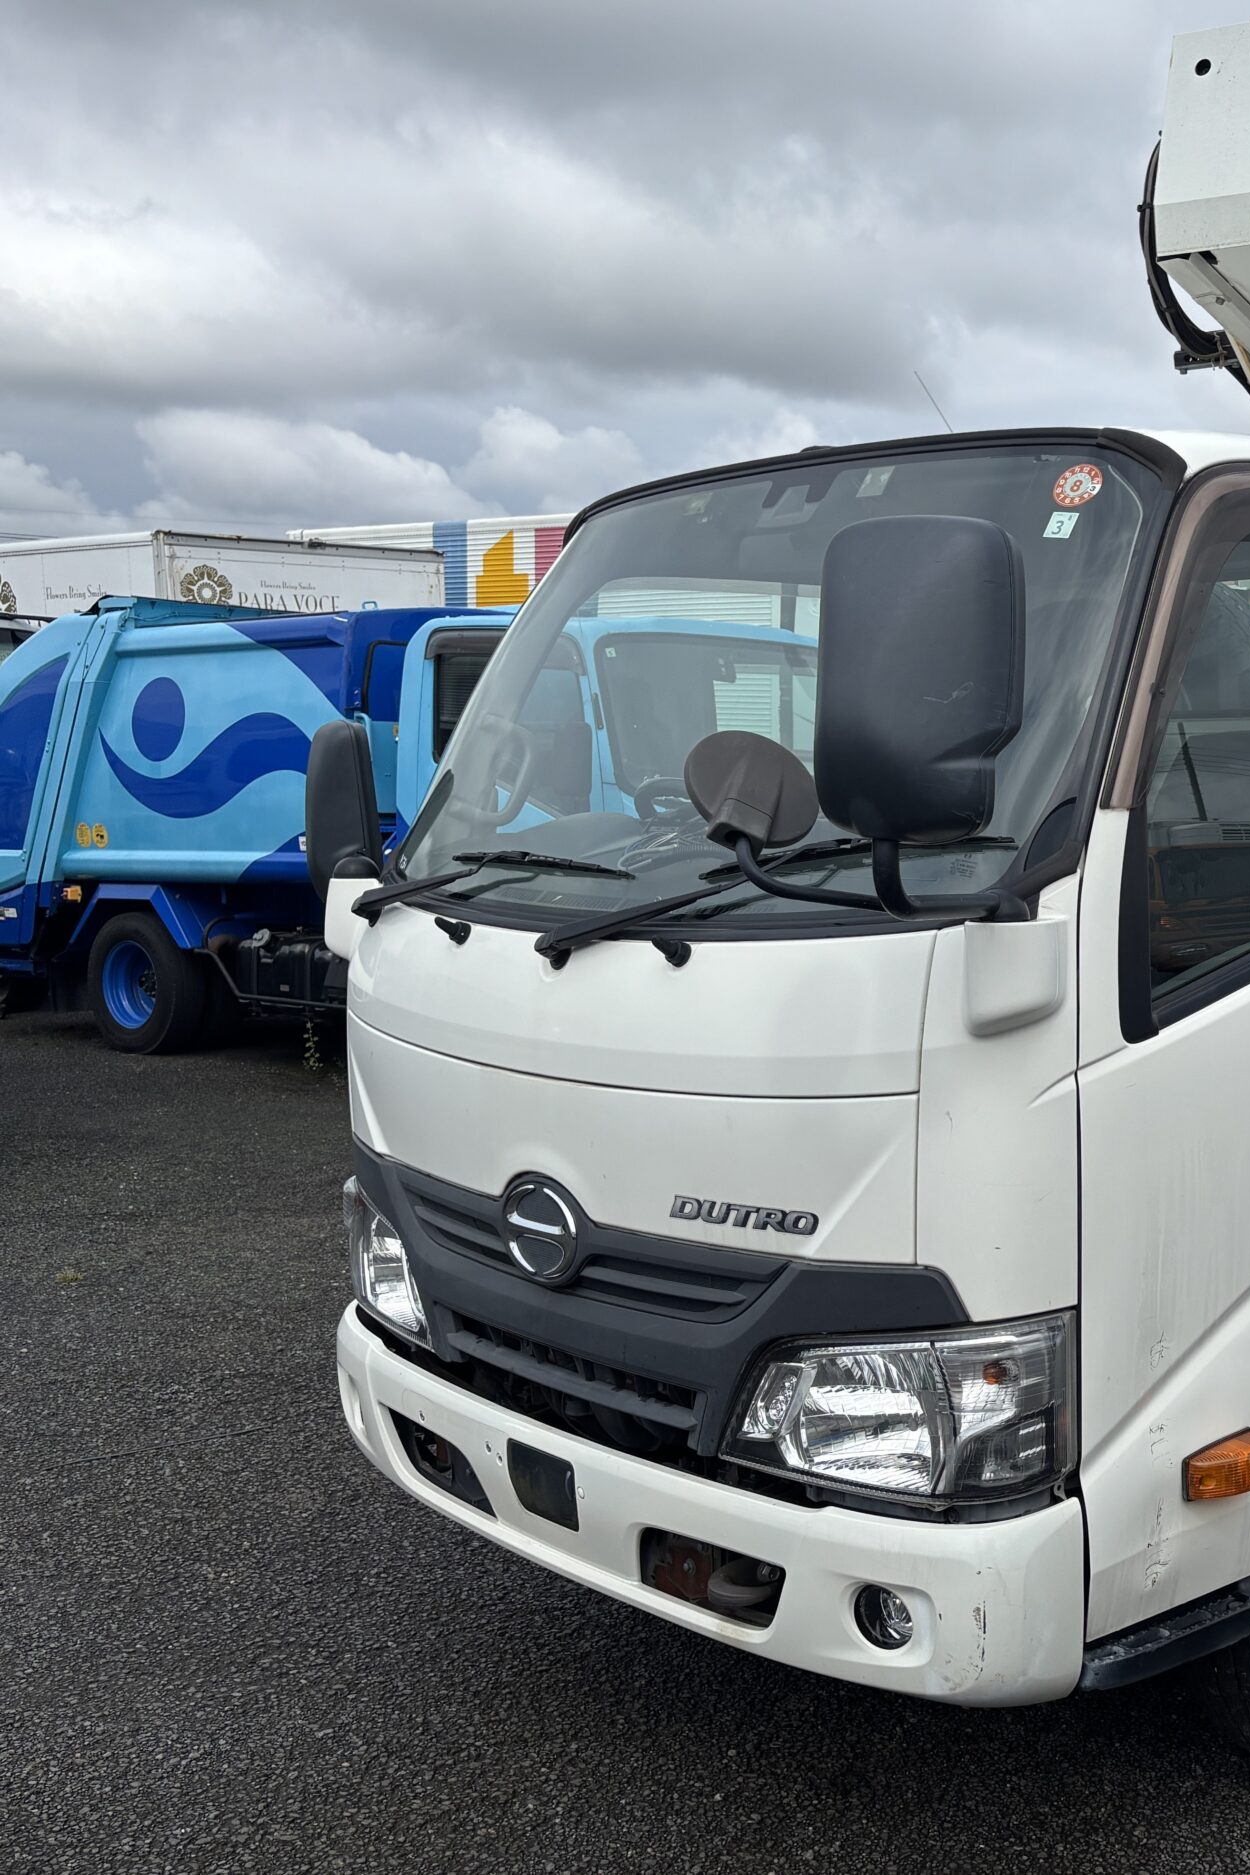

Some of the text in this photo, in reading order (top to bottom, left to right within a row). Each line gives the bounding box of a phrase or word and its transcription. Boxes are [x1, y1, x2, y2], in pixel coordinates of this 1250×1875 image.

[1069, 480, 1082, 492] 8
[1051, 520, 1064, 534] 3
[45, 586, 68, 600] Flowers
[69, 585, 87, 600] Bring
[238, 591, 340, 613] PARA VOCE
[669, 1194, 820, 1236] DUTRO
